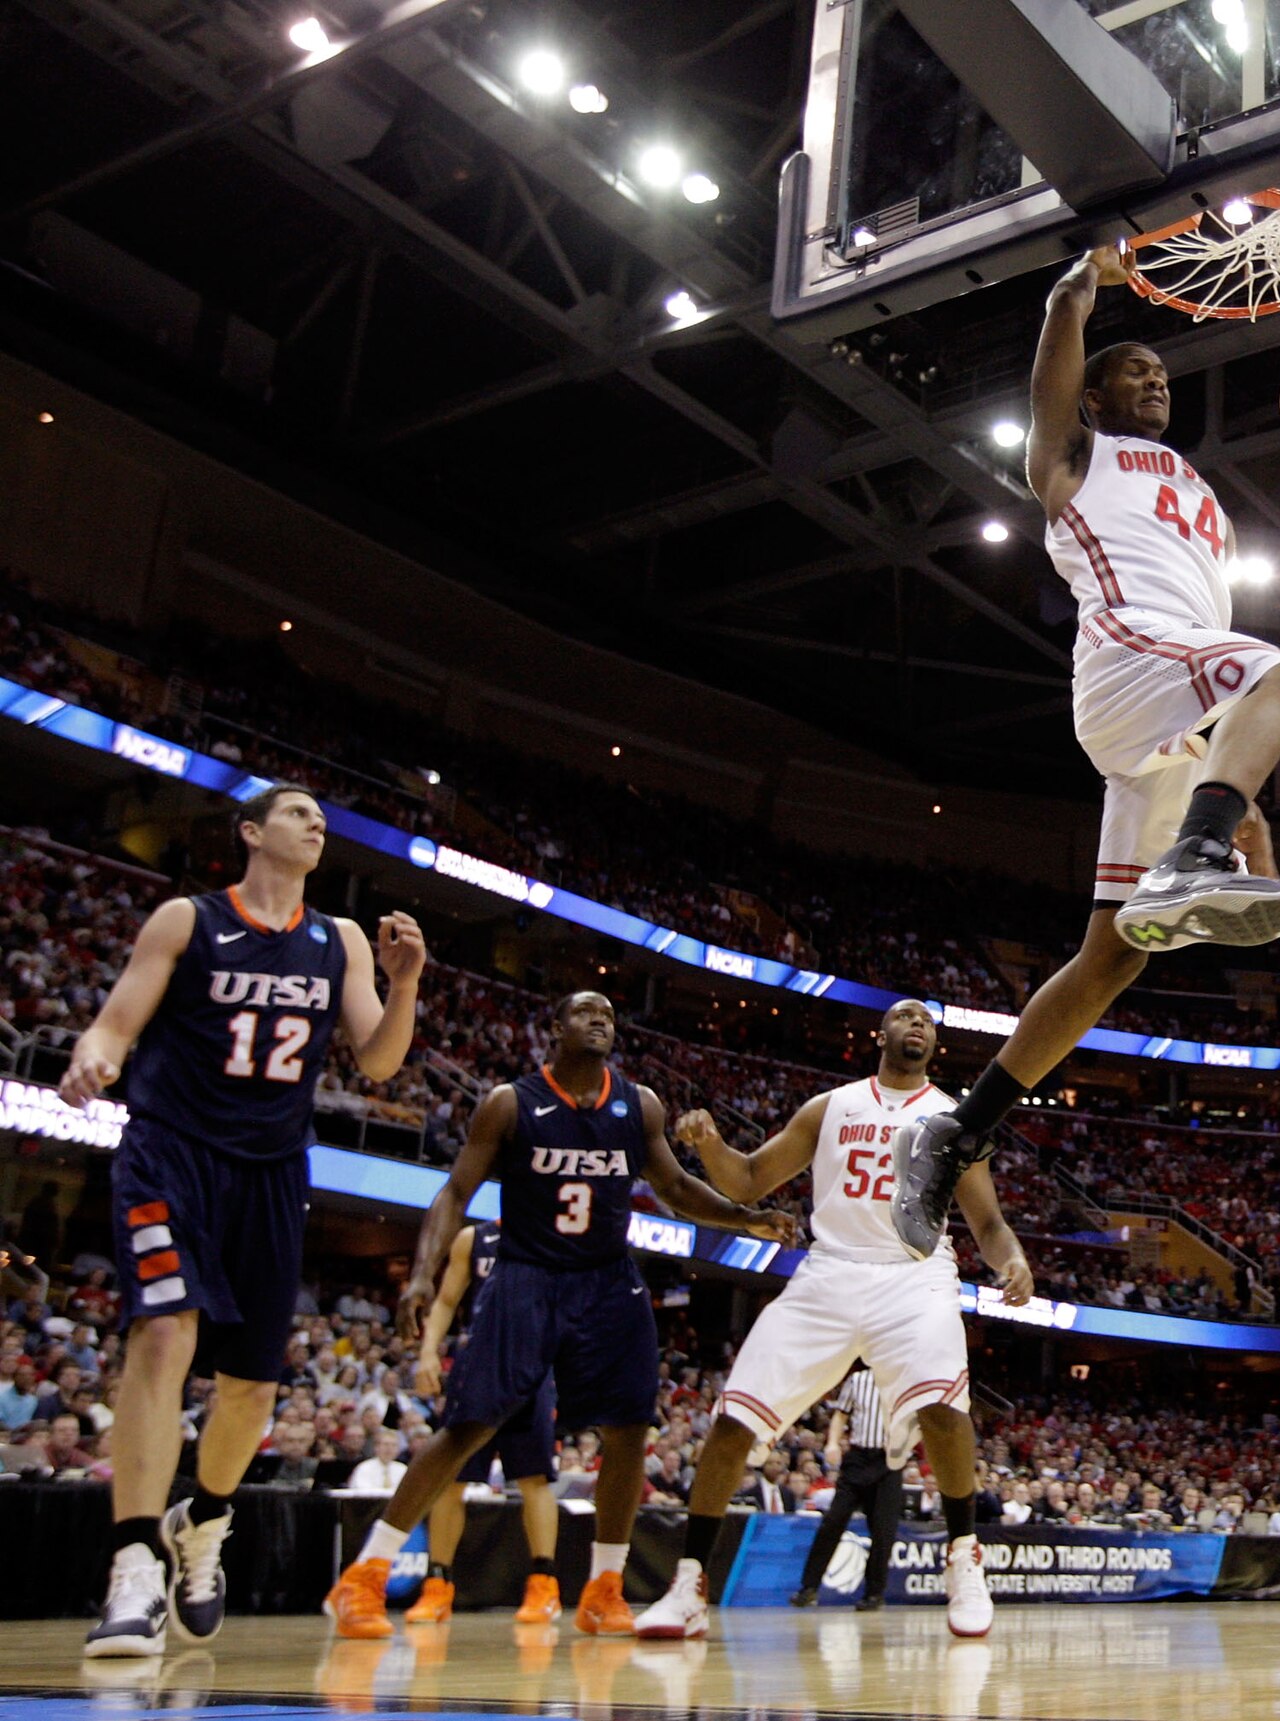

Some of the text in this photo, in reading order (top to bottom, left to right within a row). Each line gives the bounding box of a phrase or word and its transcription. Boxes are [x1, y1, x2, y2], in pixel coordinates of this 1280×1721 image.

[1117, 450, 1176, 477] OHIO
[1155, 484, 1224, 561] 44
[113, 724, 186, 777] NCAA
[705, 944, 754, 979] NCAA
[209, 970, 331, 1012] UTSA
[224, 1010, 312, 1083] 12
[1204, 1043, 1251, 1067] NCAA
[838, 1124, 901, 1145] OHIO S
[531, 1146, 629, 1176] UTSA
[844, 1149, 897, 1202] 52
[556, 1181, 593, 1236] 3
[627, 1211, 691, 1258] NCAA
[1012, 1545, 1055, 1571] AND
[1054, 1546, 1106, 1571] THIRD
[1106, 1547, 1173, 1572] ROUNDS
[985, 1574, 1026, 1594] STATE
[1102, 1574, 1137, 1594] HOST
